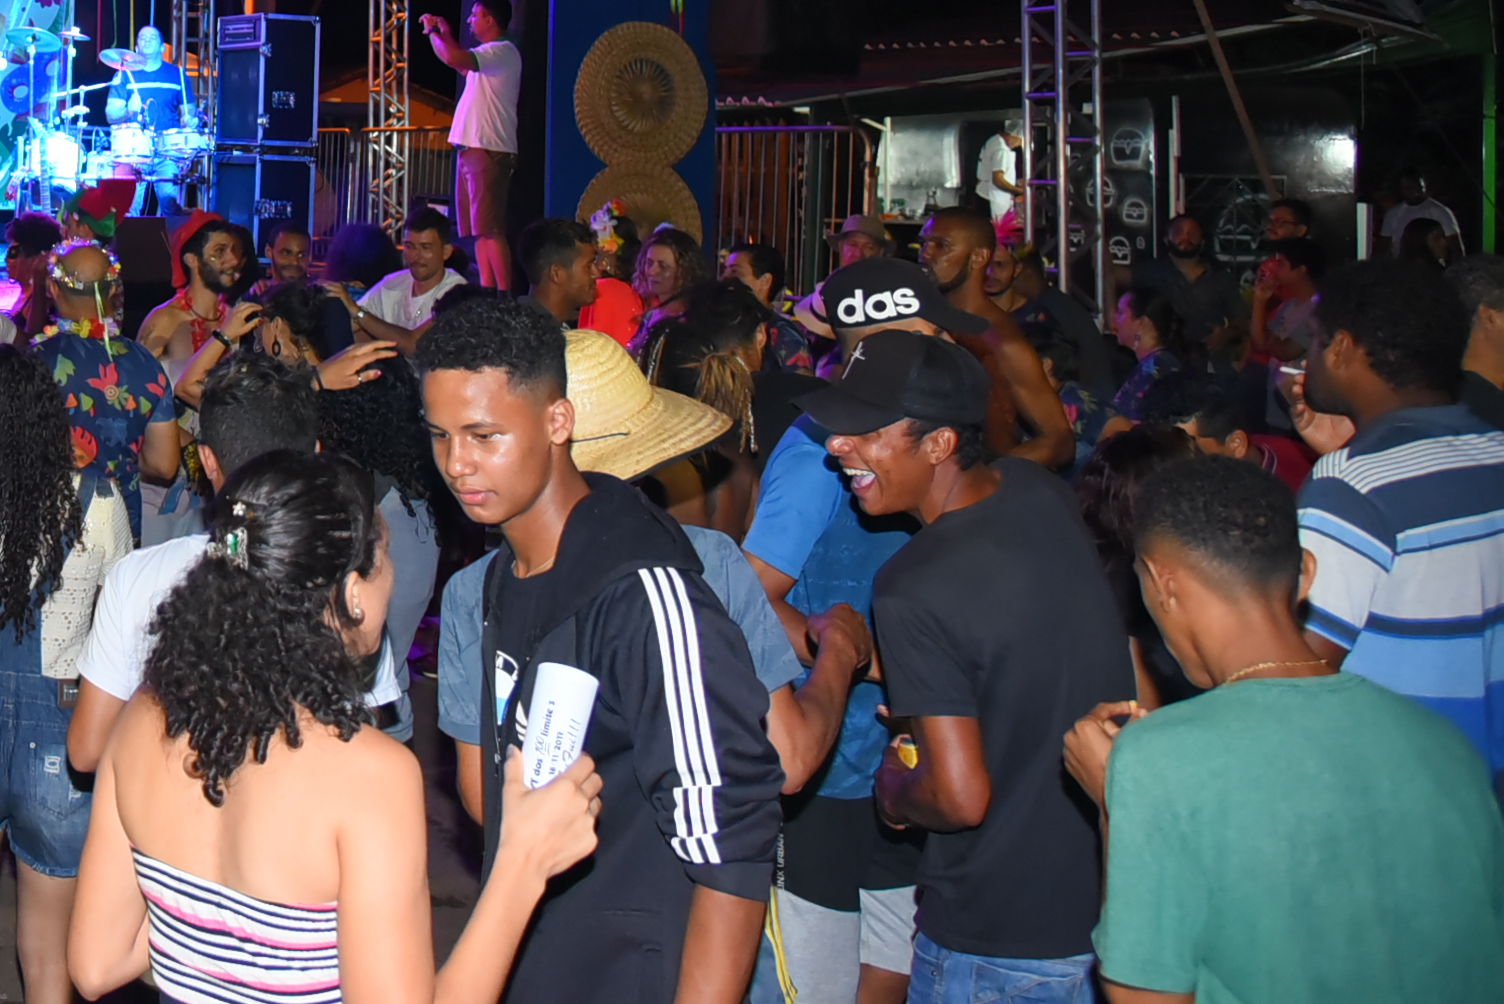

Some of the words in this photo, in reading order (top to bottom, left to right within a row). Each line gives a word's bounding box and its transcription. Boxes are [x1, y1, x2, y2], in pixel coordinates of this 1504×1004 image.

[836, 287, 921, 324] das
[532, 758, 543, 776] dos
[776, 833, 785, 867] URBAN
